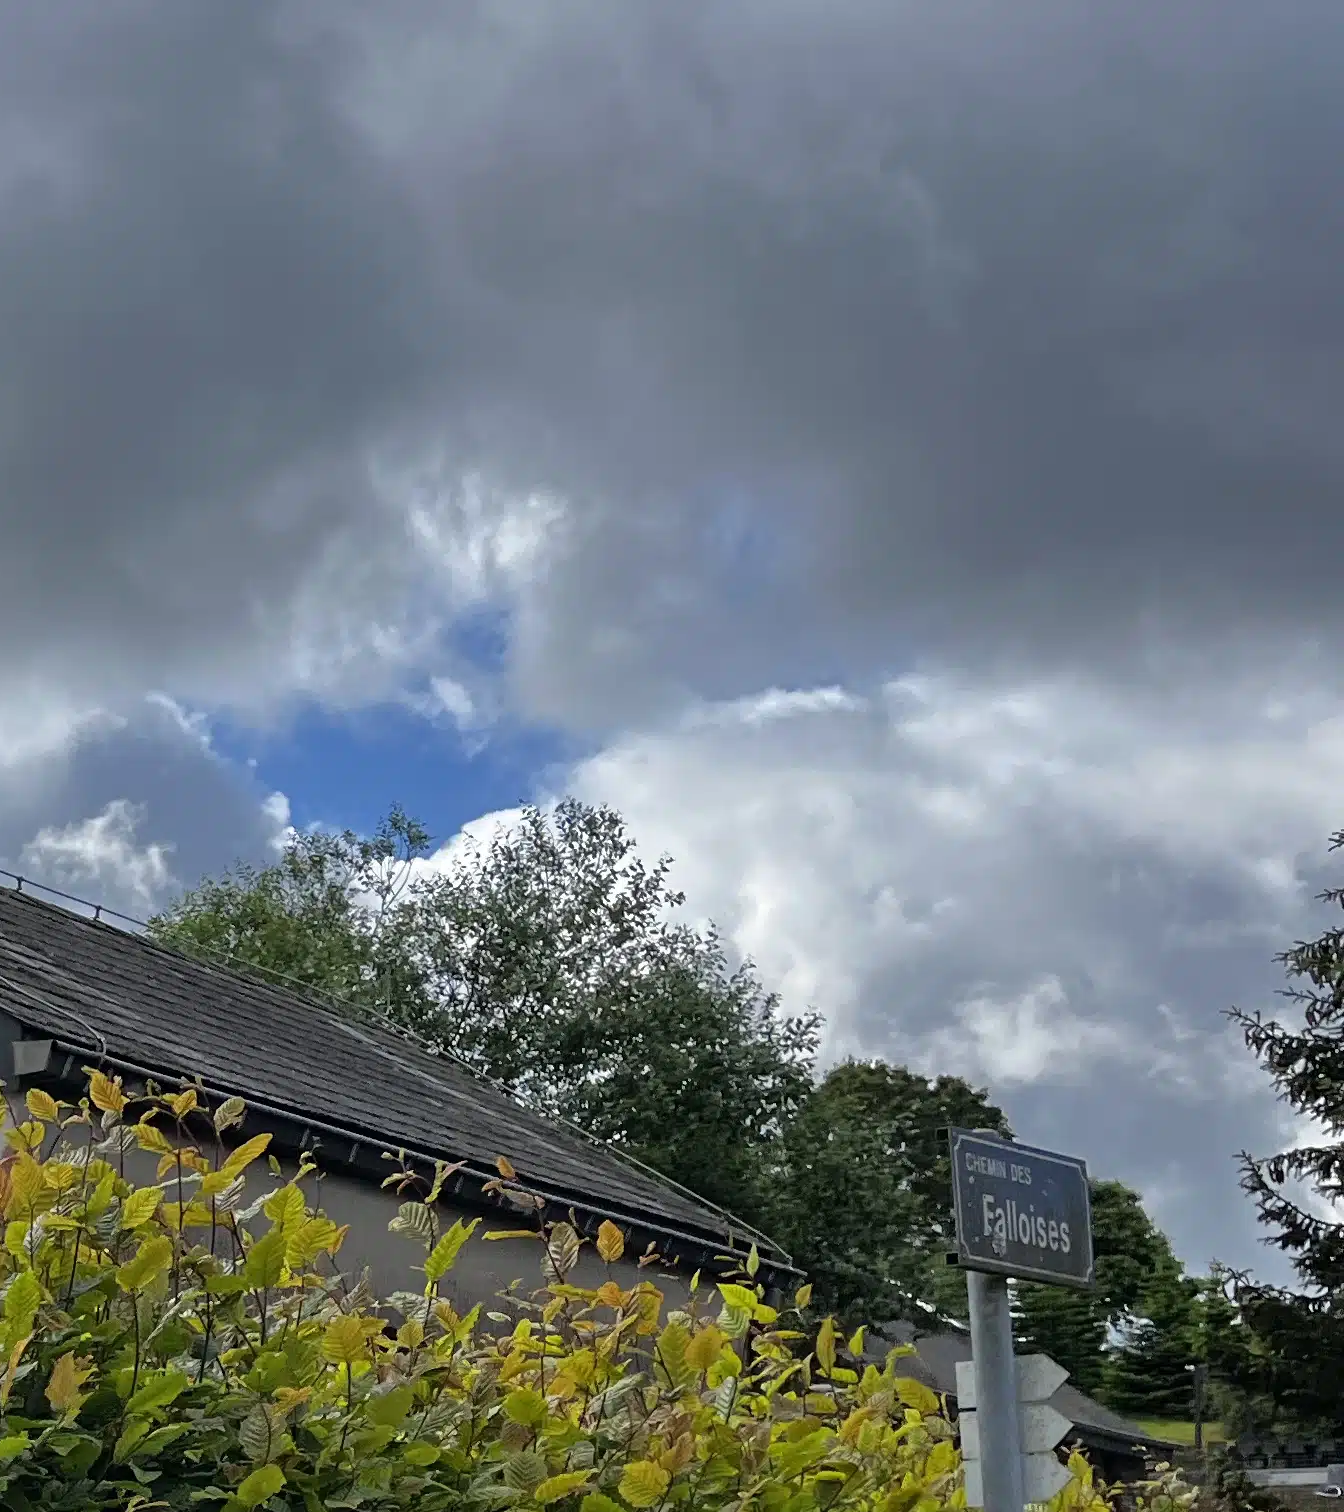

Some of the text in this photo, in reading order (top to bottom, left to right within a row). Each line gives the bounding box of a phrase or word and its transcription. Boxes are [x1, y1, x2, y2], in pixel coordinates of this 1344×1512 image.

[965, 1152, 1032, 1185] CHEMIN DES
[982, 1193, 1072, 1254] Falloises
